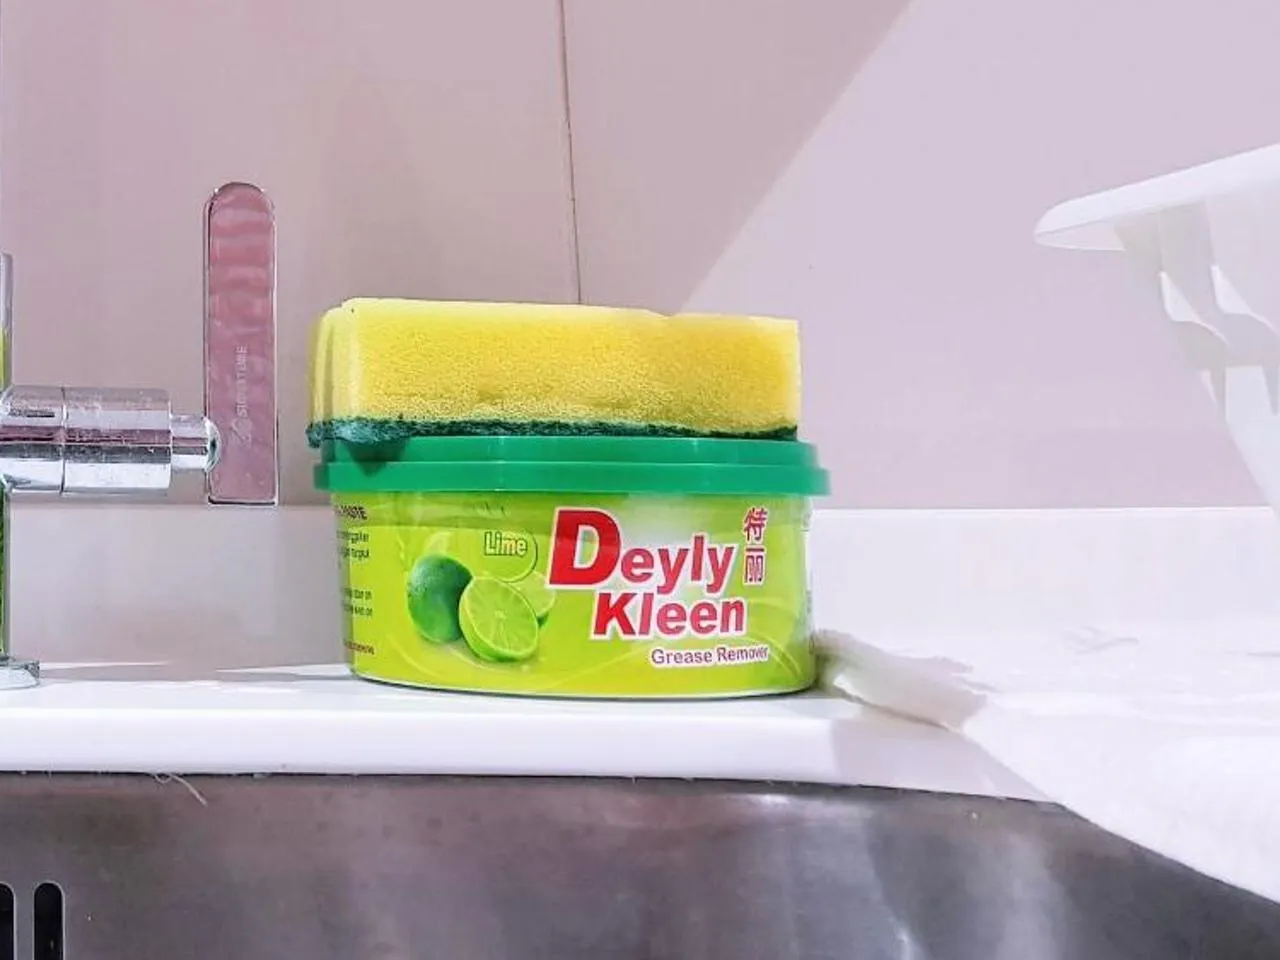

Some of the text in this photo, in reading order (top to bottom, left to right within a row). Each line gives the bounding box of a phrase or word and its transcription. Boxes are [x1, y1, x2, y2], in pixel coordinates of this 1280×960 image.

[484, 531, 528, 557] Lime
[549, 509, 735, 594] Deyly
[593, 593, 745, 636] Kleen
[651, 649, 713, 664] Grease
